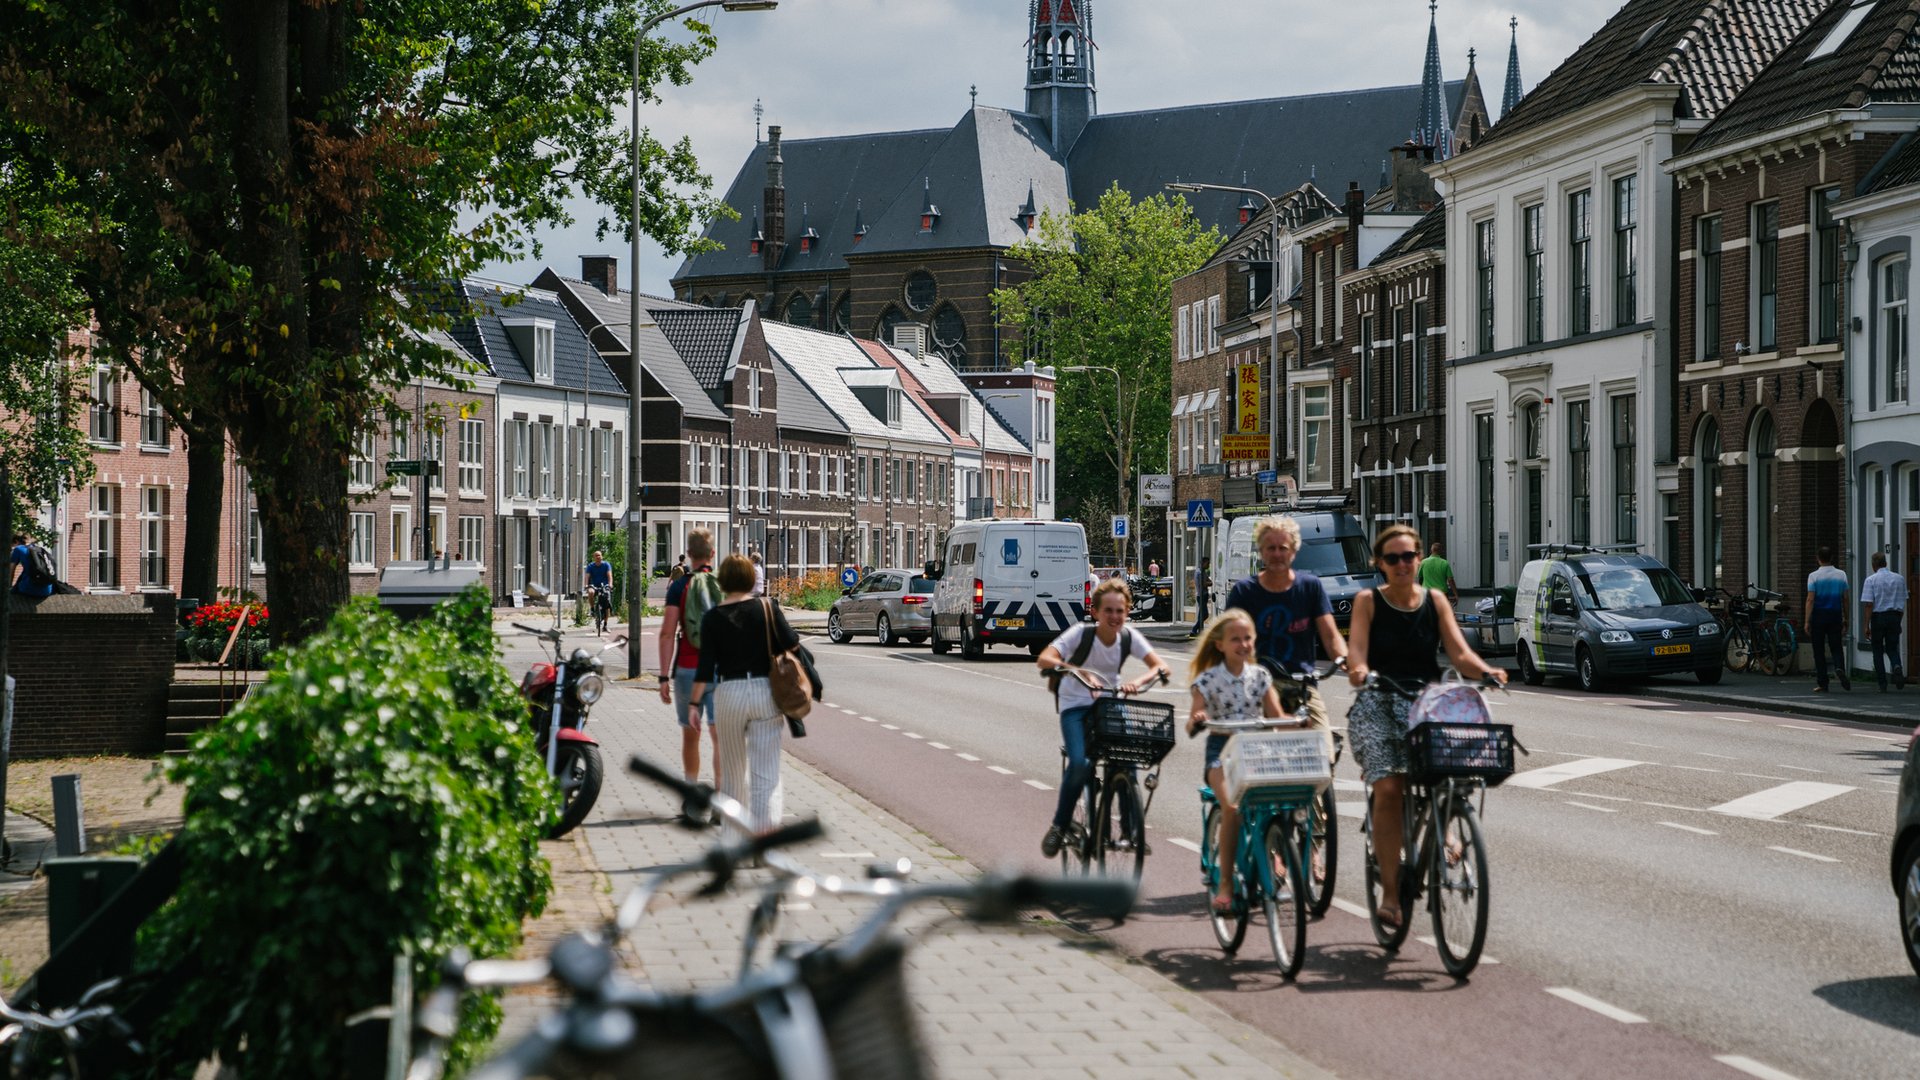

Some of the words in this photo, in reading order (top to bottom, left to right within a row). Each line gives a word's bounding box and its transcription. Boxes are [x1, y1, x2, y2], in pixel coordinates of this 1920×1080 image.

[1222, 449, 1253, 458] LANGE
[1256, 449, 1270, 458] KO
[1117, 521, 1123, 529] P
[1069, 583, 1083, 592] 358
[1540, 586, 1547, 608] R
[1655, 645, 1689, 654] 92-BN-XH
